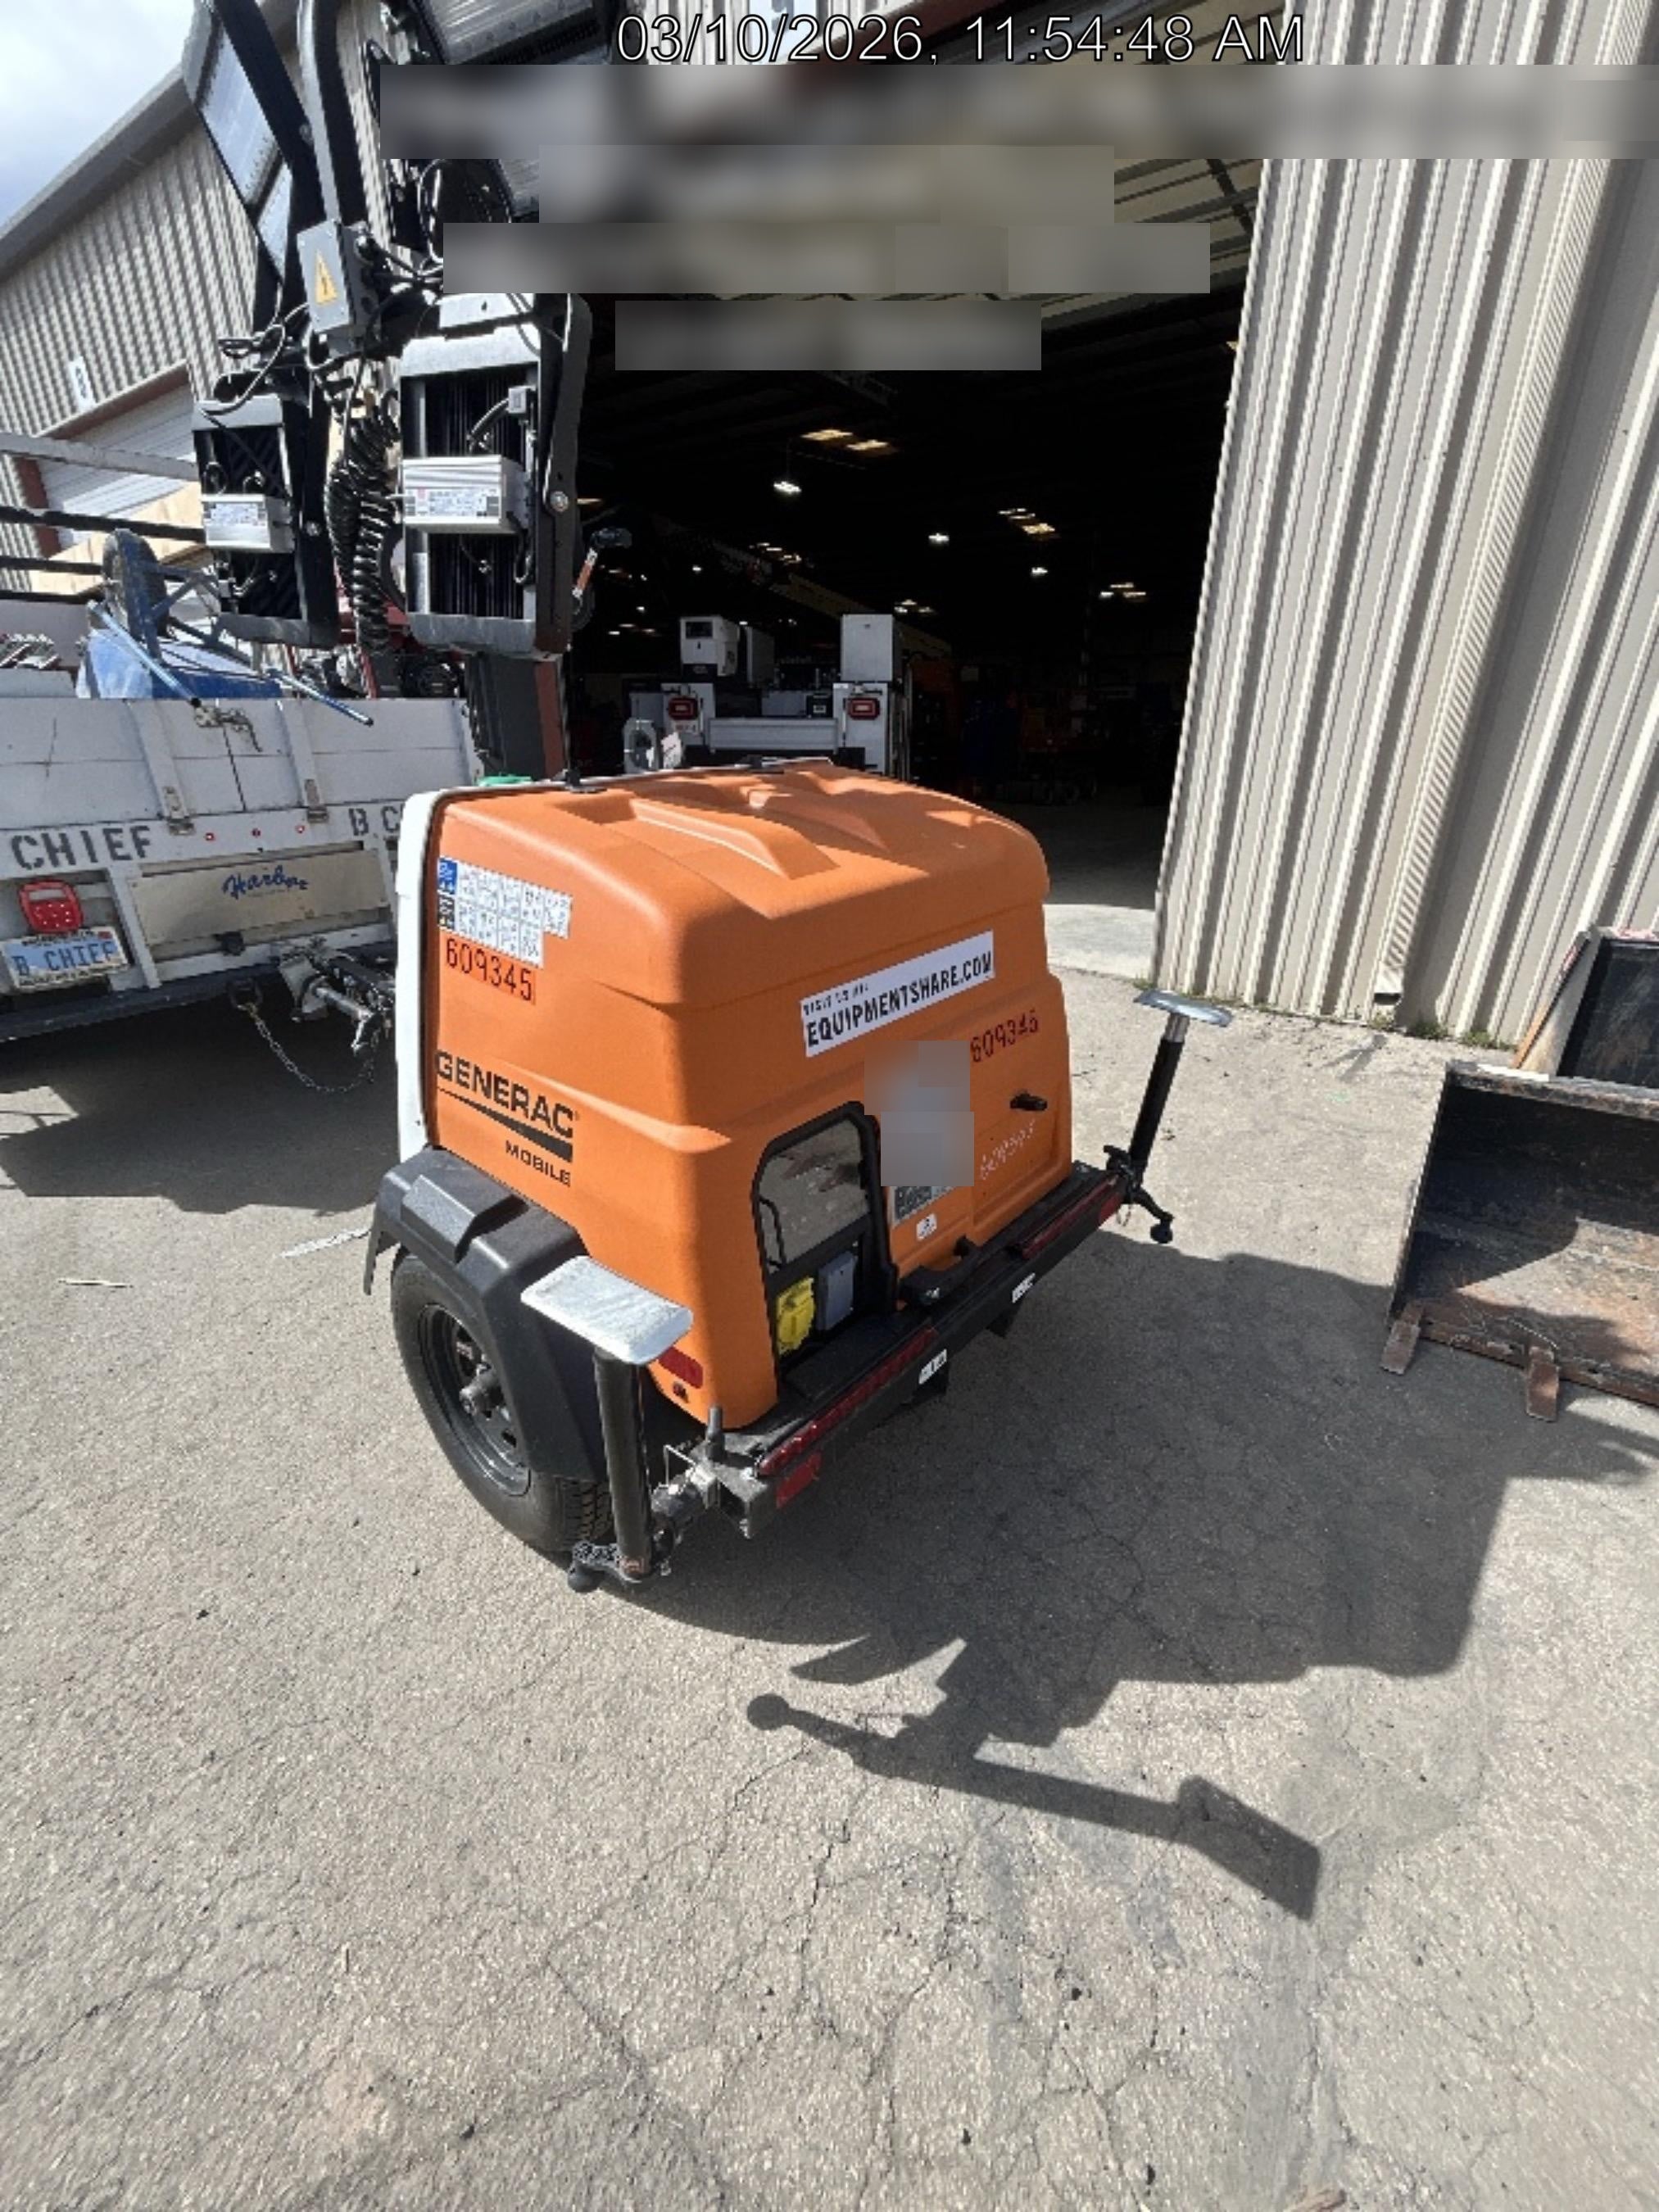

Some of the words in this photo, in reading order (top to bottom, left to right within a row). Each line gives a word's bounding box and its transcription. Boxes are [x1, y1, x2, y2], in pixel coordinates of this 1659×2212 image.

[348, 807, 369, 836] B
[381, 803, 406, 833] C
[11, 825, 151, 870] CHIEF
[11, 955, 30, 976] B
[43, 941, 116, 972] CHIEF
[446, 937, 532, 1001] 609345
[806, 950, 992, 1049] EQUIPMENTSHARE.COM
[434, 1049, 574, 1140] GENERAC
[505, 1140, 572, 1188] MOBILE
